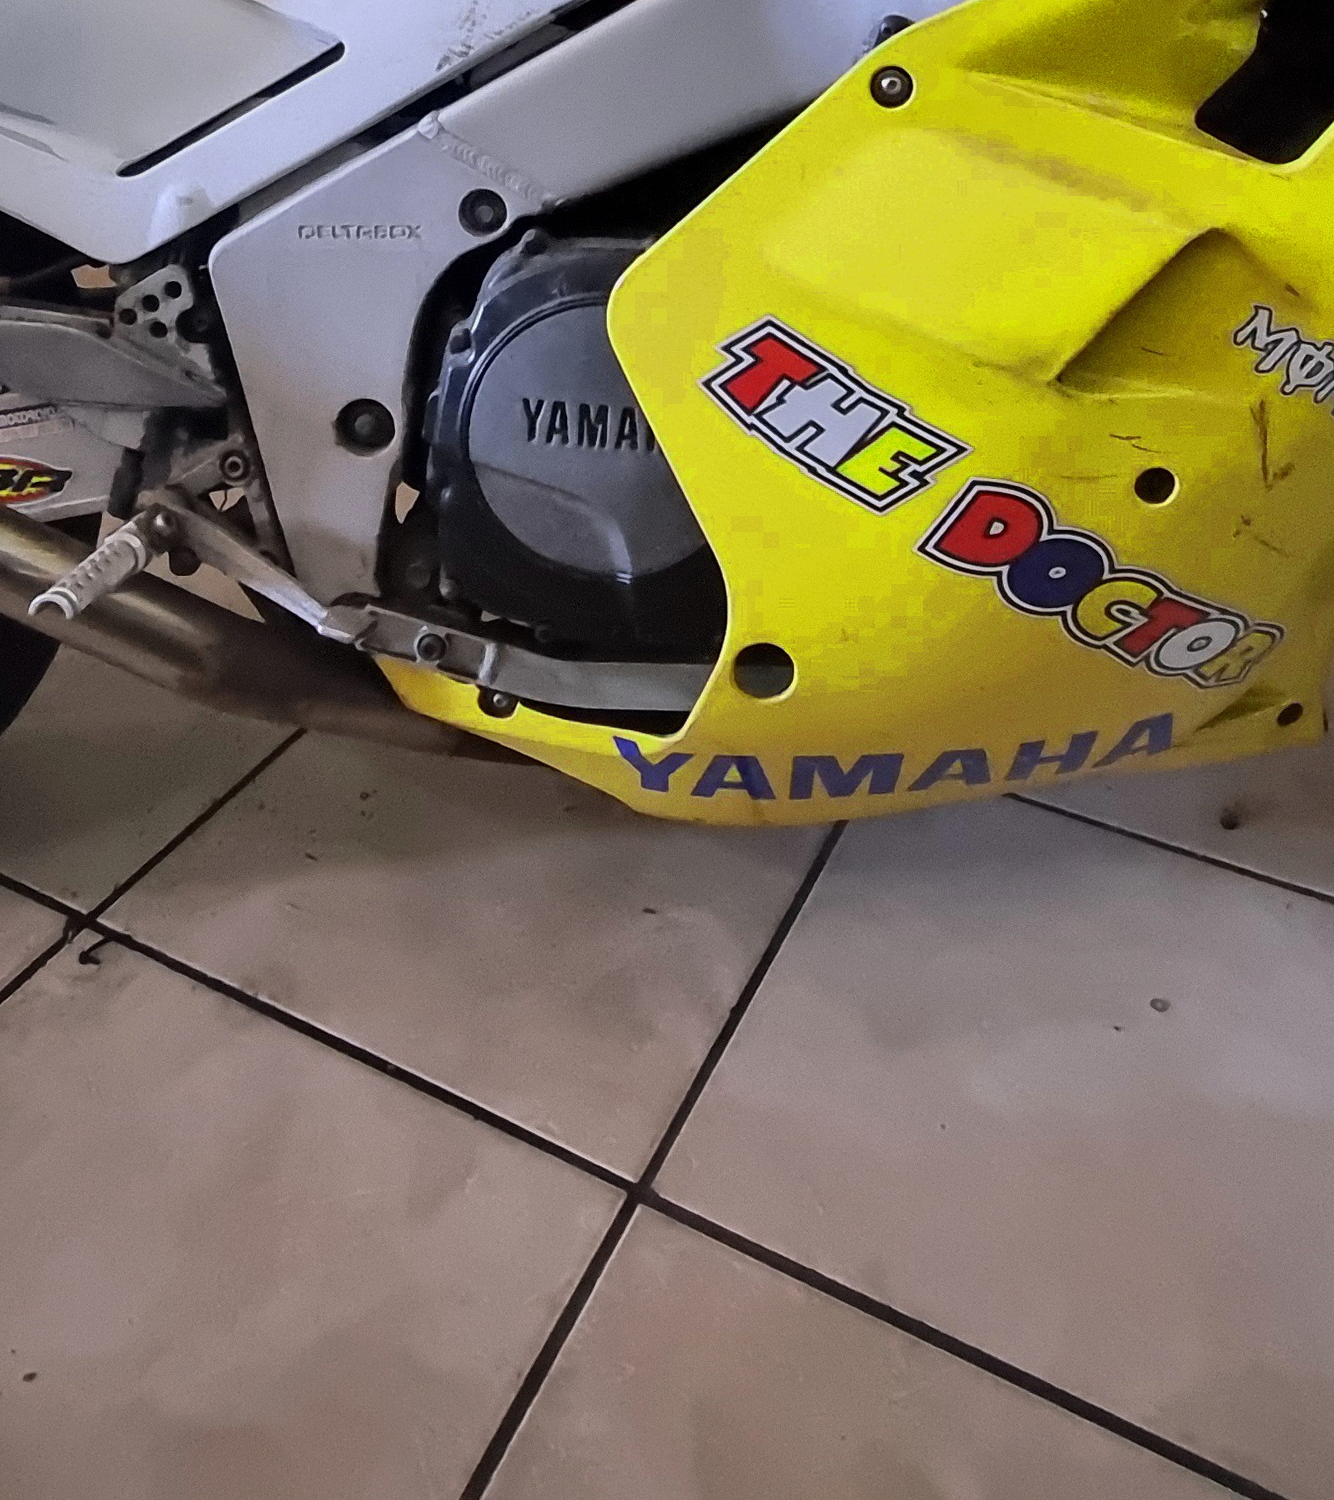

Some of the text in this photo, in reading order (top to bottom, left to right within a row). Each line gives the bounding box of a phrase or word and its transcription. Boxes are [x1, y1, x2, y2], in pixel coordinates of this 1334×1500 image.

[297, 223, 422, 240] DELTABOX
[703, 320, 1283, 687] THE DOCTOR
[611, 712, 1174, 801] YAMAHA
